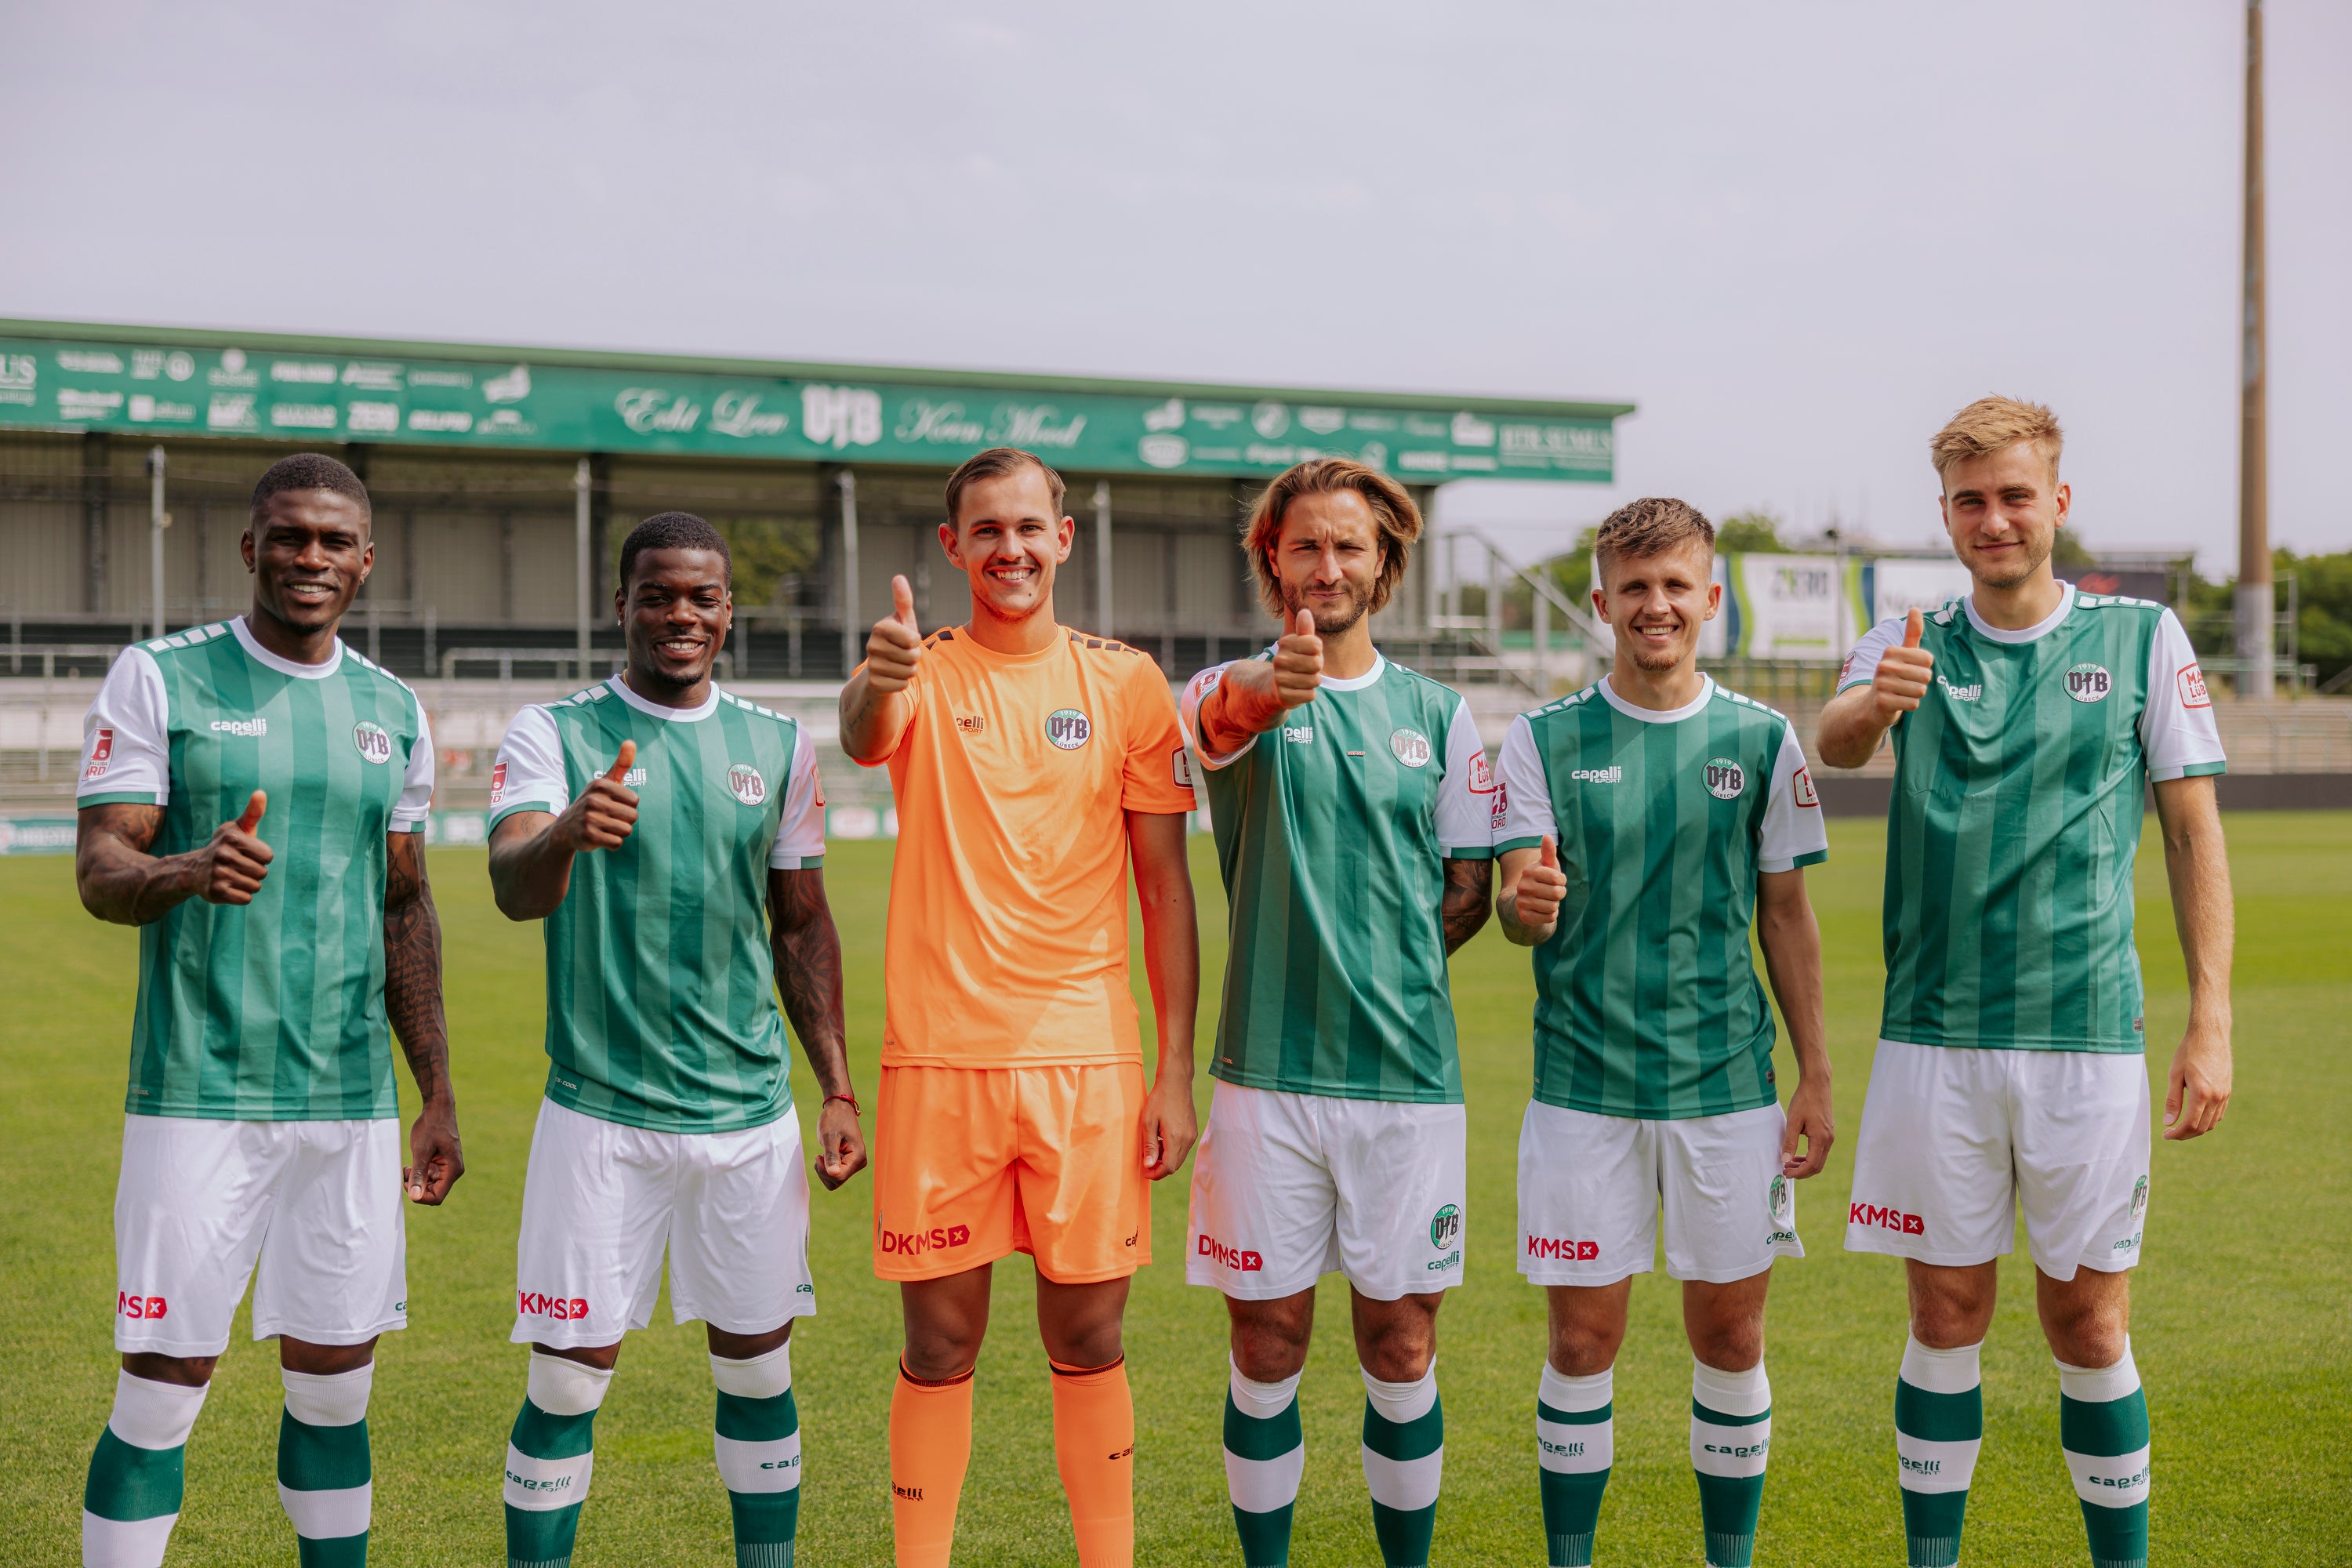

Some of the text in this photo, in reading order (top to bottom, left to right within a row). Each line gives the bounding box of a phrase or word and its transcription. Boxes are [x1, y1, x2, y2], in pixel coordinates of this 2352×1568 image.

[1936, 675, 1982, 696] cpelli
[2068, 671, 2108, 695] VfB
[2186, 670, 2203, 685] MA
[210, 719, 267, 734] capelli
[362, 721, 378, 731] 1919
[1050, 713, 1087, 741] VfB
[356, 728, 389, 756] VfB
[1393, 734, 1428, 760] VfB
[87, 766, 107, 777] RD
[593, 769, 647, 781] celli
[731, 770, 764, 797] VfB
[1571, 766, 1621, 782] capelli
[1706, 764, 1742, 791] VfB
[1711, 790, 1735, 799] LÜBECK
[1434, 1214, 1459, 1240] VfB
[1849, 1203, 1901, 1231] KMS
[882, 1229, 947, 1255] DKMS
[1198, 1234, 1240, 1270] DKMS
[1528, 1234, 1575, 1261] KMS
[1427, 1250, 1460, 1271] capelli
[520, 1292, 568, 1320] KMS
[506, 1469, 572, 1489] capelli
